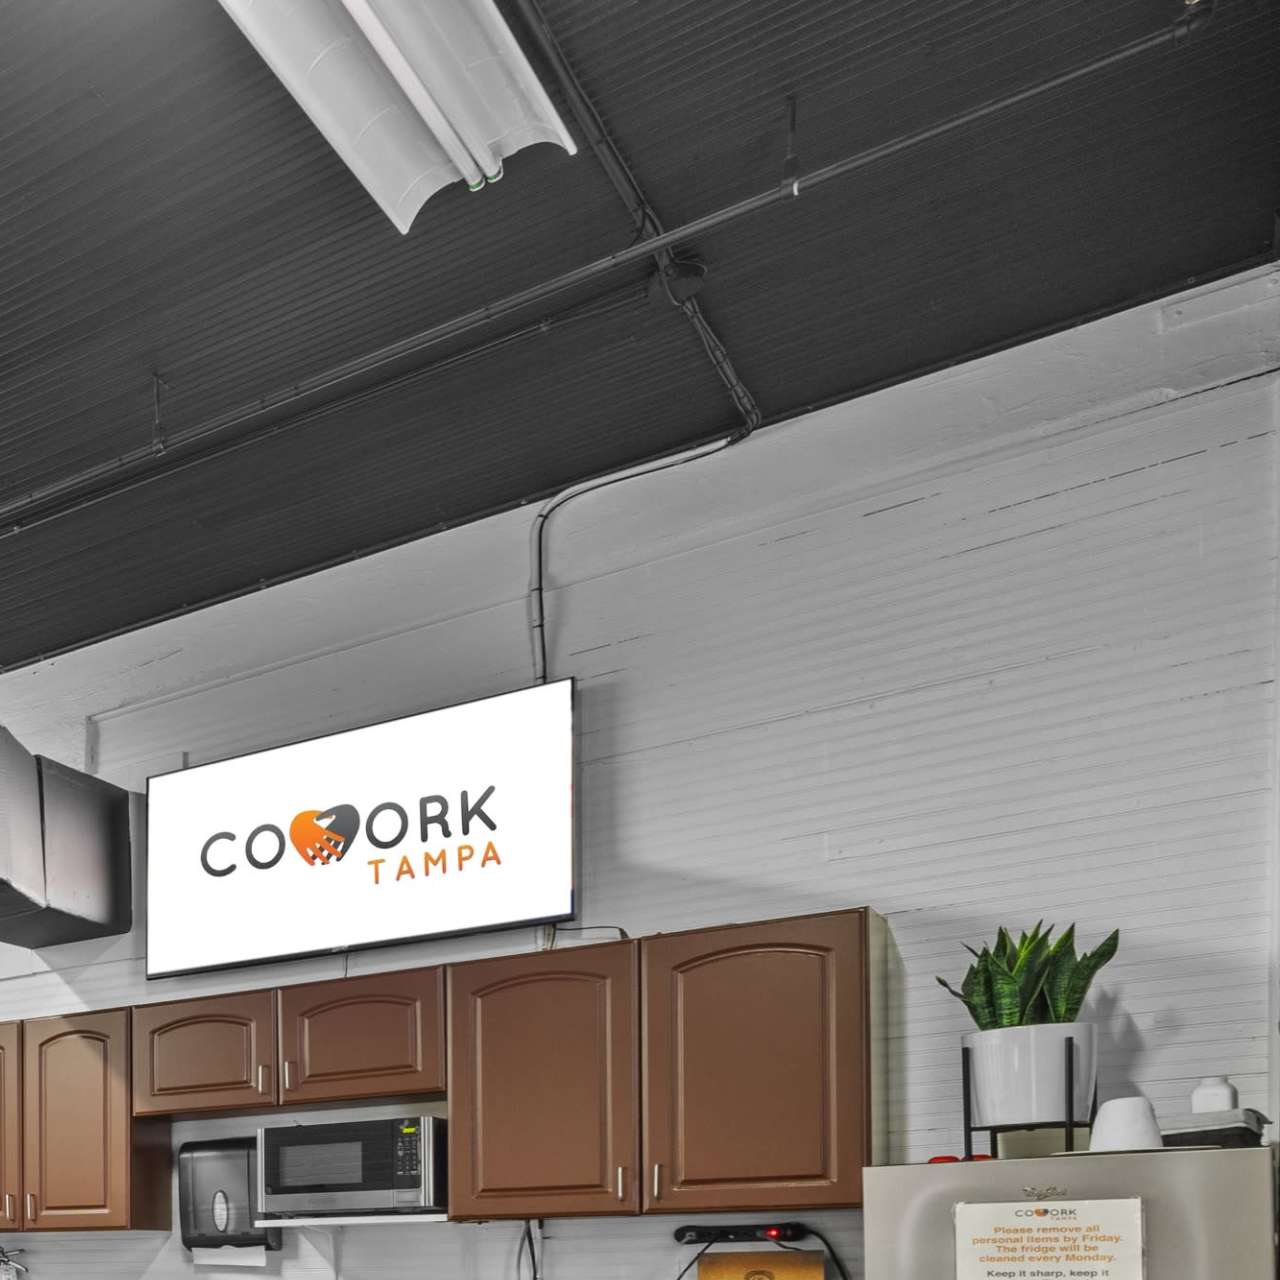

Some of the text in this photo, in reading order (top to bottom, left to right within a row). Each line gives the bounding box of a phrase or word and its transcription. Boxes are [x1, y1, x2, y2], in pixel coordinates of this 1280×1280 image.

[368, 841, 501, 885] TAMPA
[1086, 1225, 1100, 1233] all
[972, 1236, 1024, 1245] personal
[1063, 1235, 1078, 1243] by
[996, 1245, 1018, 1253] The
[1021, 1245, 1057, 1254] fridge
[1059, 1244, 1080, 1252] will
[979, 1254, 1116, 1263] cleaned every Monday.
[986, 1270, 1016, 1278] Keep
[1030, 1270, 1066, 1278] sharp,
[1070, 1270, 1098, 1278] keep
